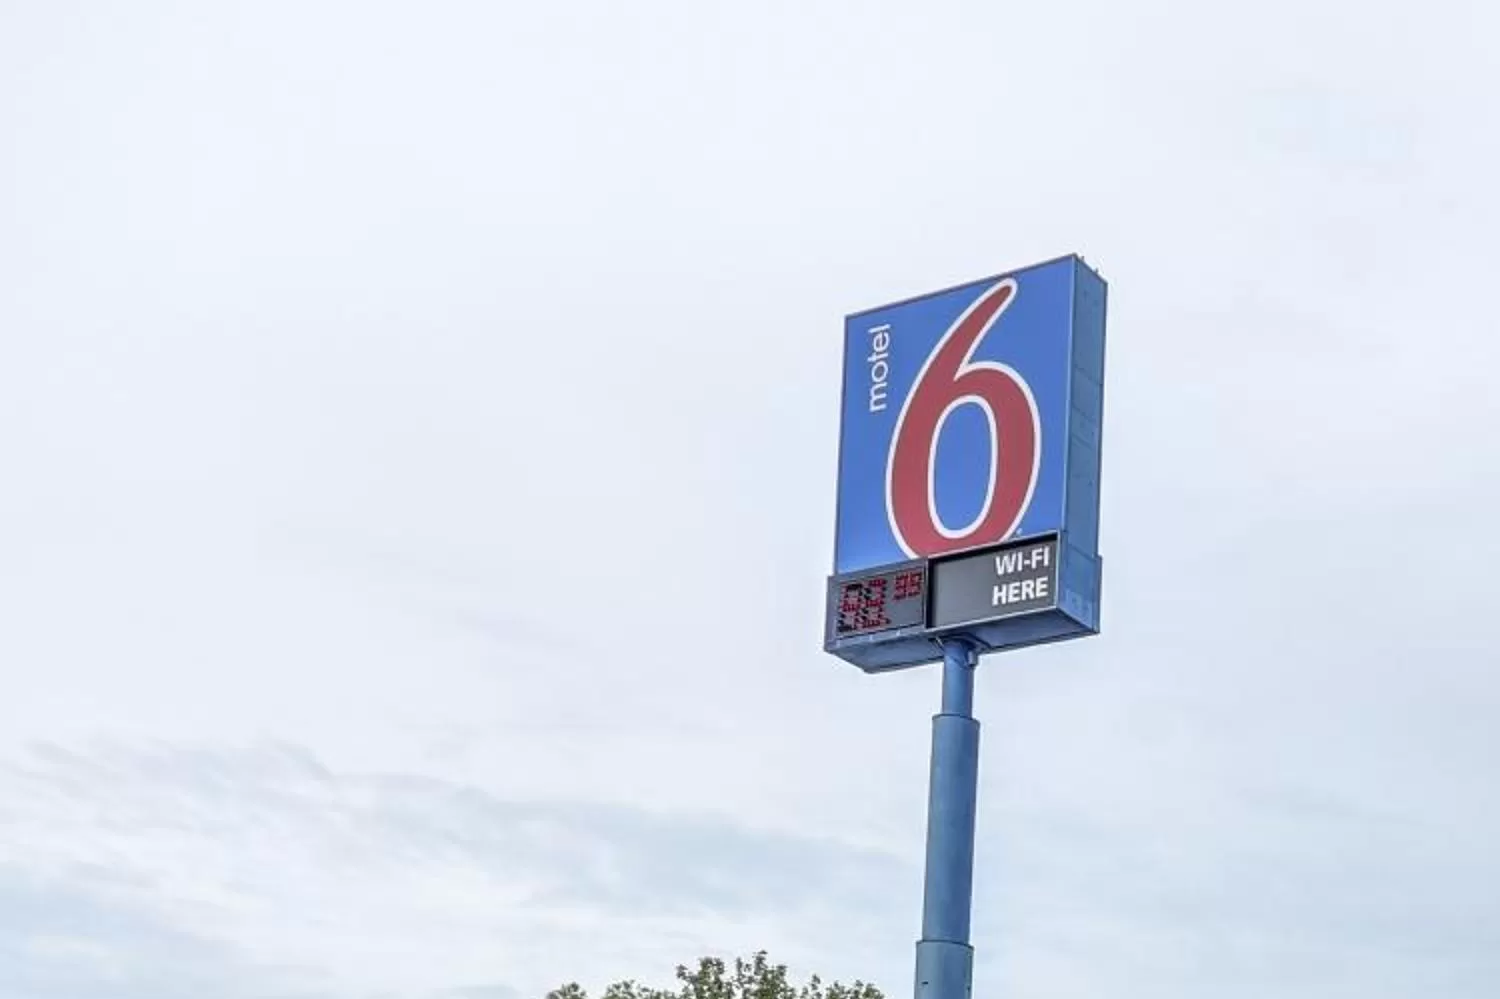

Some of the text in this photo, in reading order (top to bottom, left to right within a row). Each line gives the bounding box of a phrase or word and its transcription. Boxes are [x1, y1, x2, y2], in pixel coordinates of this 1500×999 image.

[868, 277, 1041, 560] motel 6
[995, 545, 1050, 576] WI-FI
[991, 575, 1049, 607] HERE
